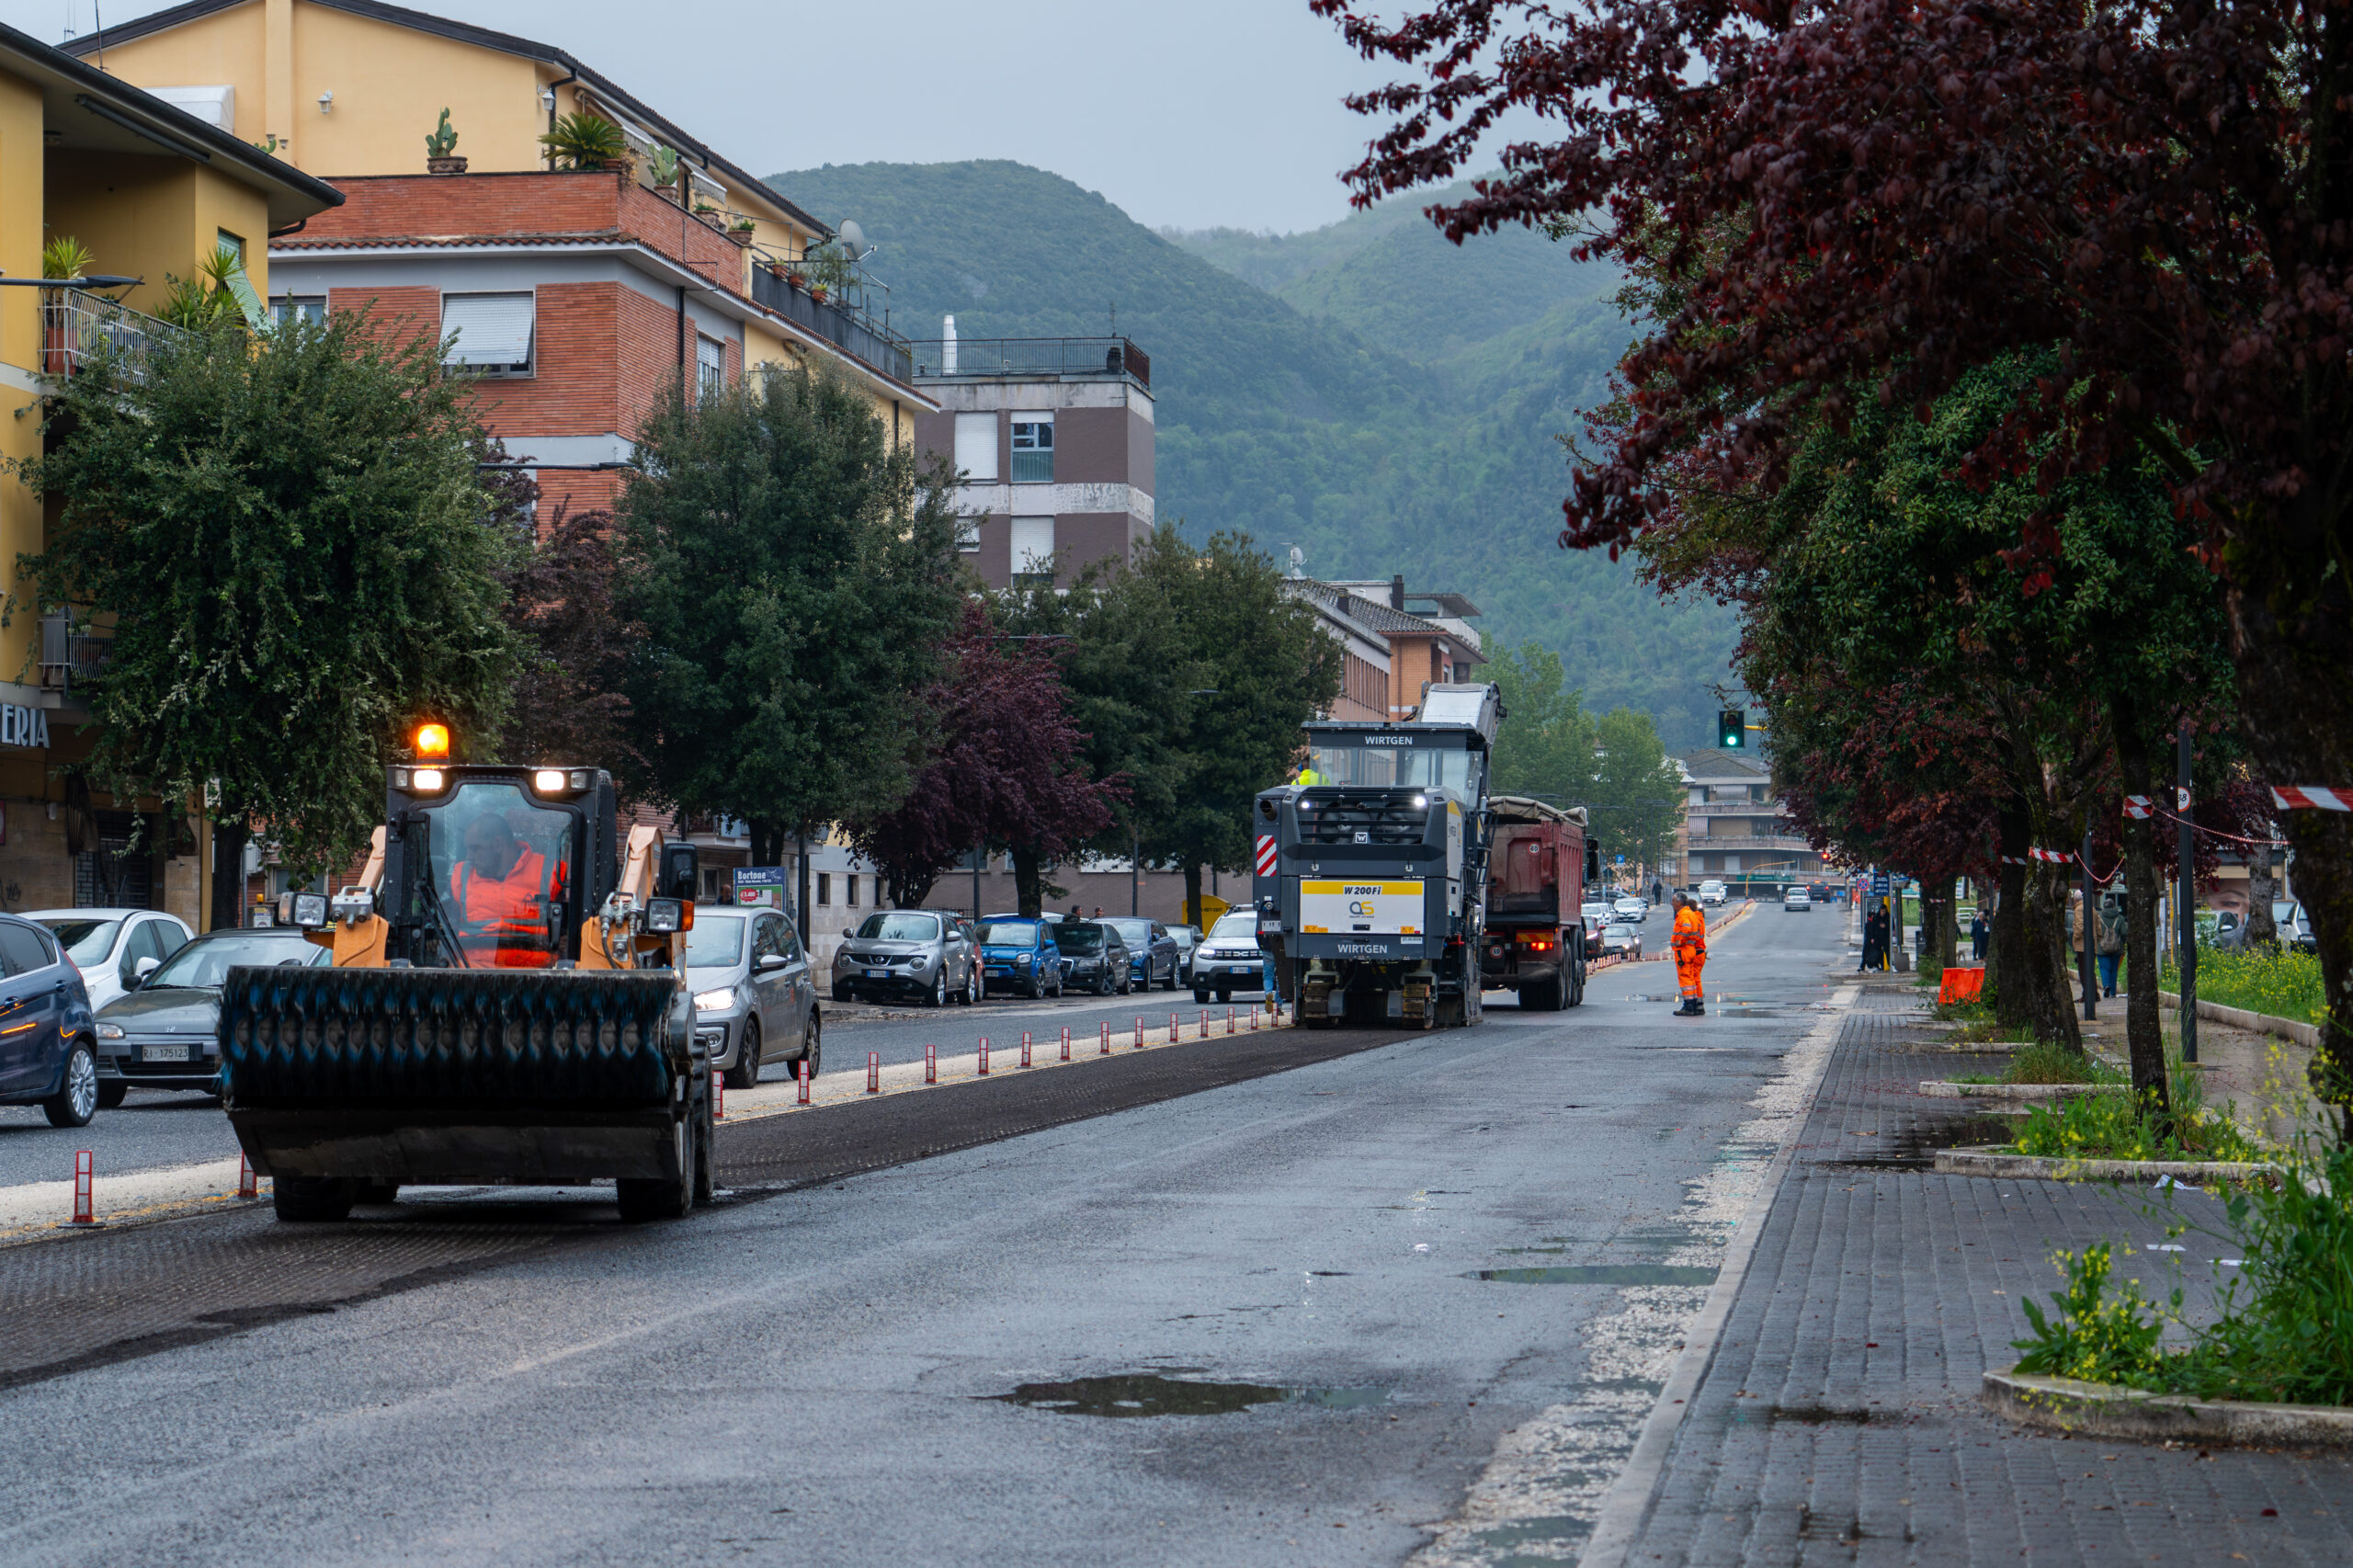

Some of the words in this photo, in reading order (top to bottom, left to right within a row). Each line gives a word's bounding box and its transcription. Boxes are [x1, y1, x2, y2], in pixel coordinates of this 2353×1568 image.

[0, 703, 50, 748] ERIA
[1365, 735, 1413, 745] WIRTGEN
[737, 870, 767, 880] Bortone
[1344, 886, 1353, 895] W
[1337, 945, 1388, 954] WIRTGEN
[143, 1049, 153, 1058] RI
[160, 1049, 188, 1058] 175123
